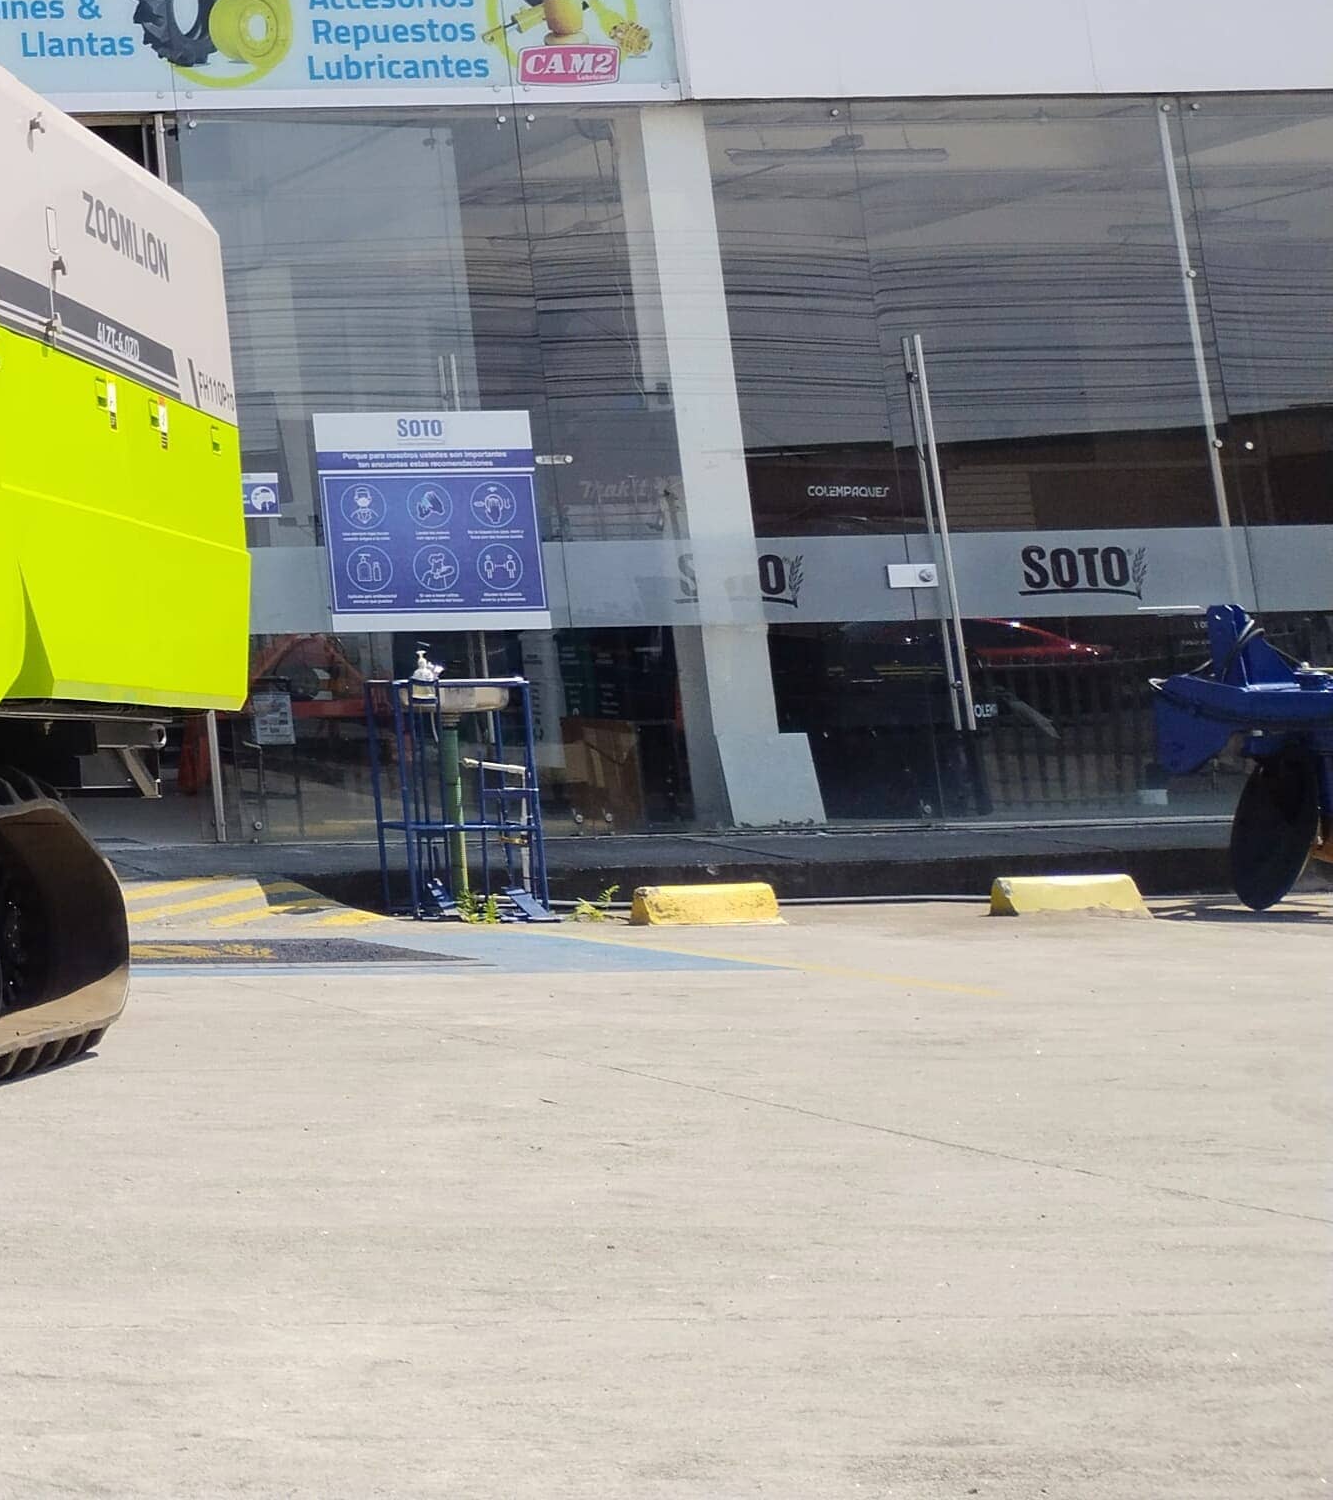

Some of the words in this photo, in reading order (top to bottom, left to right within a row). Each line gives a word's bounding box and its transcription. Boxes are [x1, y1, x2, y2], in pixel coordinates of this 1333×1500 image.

[20, 31, 135, 58] Llantas
[311, 18, 476, 51] Repuestos
[307, 53, 490, 81] Lubricantes
[525, 52, 614, 75] CAM2
[81, 190, 171, 283] ZOOMLION
[396, 418, 443, 438] SOTO
[1021, 545, 1130, 589] SOTO
